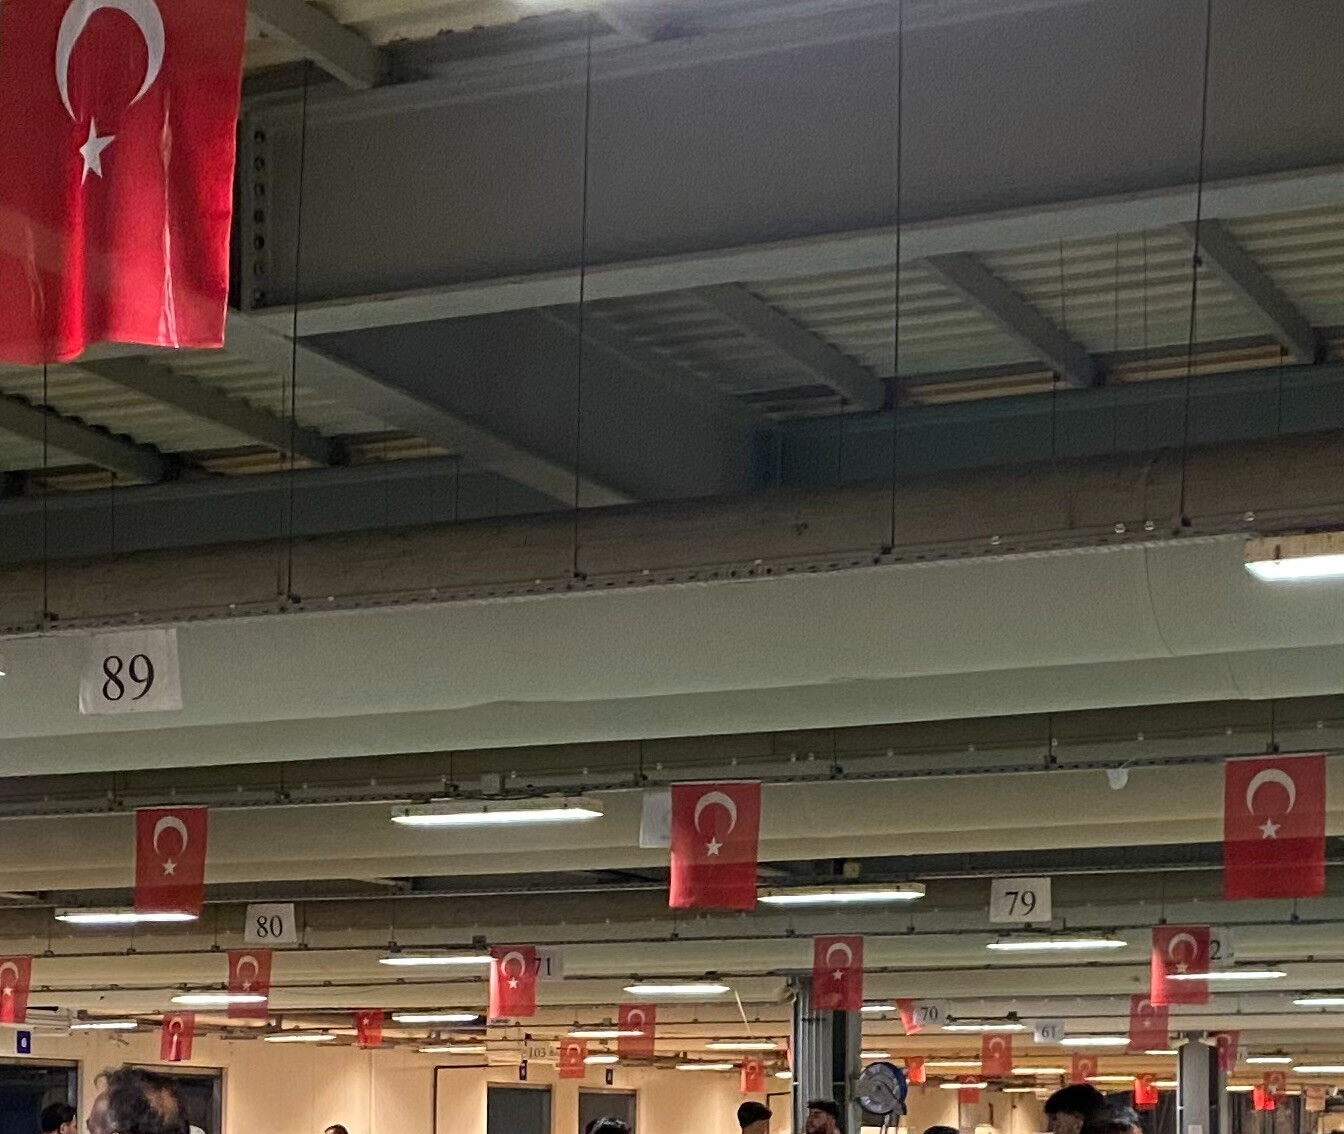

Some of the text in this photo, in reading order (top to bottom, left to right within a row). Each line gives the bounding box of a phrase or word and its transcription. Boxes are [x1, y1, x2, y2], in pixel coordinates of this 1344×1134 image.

[102, 654, 154, 701] 89
[1005, 890, 1036, 916] 79
[257, 915, 282, 937] 80
[534, 957, 551, 977] 71
[921, 1006, 938, 1021] 70
[1041, 1026, 1056, 1038] 61
